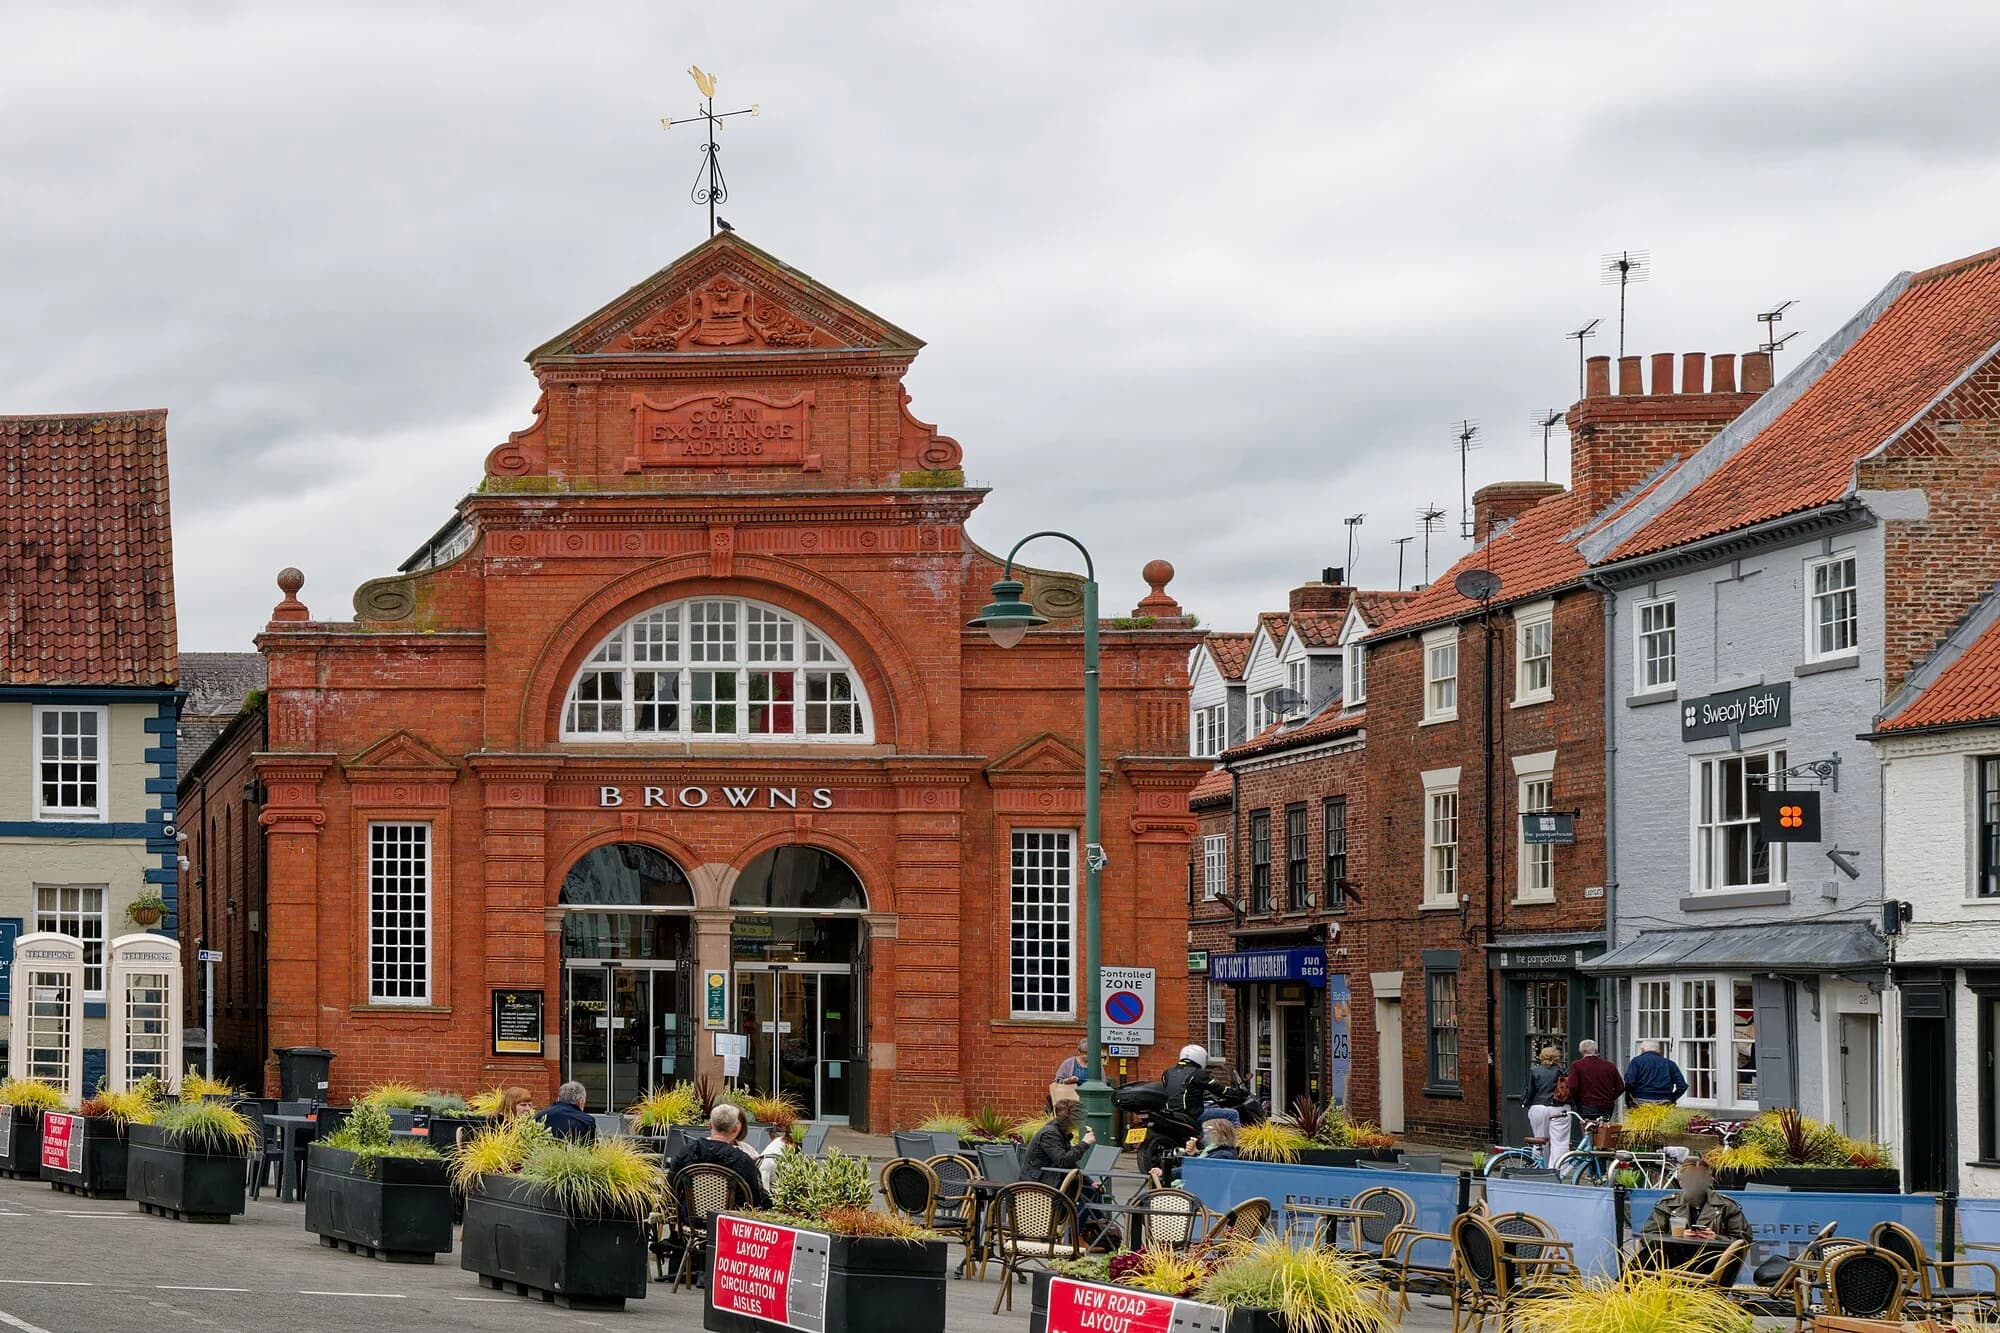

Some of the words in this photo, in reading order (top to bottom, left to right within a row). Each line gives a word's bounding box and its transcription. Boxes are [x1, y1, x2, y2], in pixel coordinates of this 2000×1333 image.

[690, 409, 756, 423] CORN
[652, 423, 795, 441] EXCHANGE
[1703, 699, 1747, 724] Sweaty
[1749, 693, 1780, 718] Betty
[599, 786, 834, 809] BROWNS
[28, 950, 75, 960] TELEPHONE
[124, 952, 170, 960] TELEPHONE
[1516, 953, 1526, 964] the
[1527, 950, 1568, 967] pamperhouse
[1100, 969, 1152, 979] Controlled
[1248, 954, 1287, 978] AMUSEMENTS
[1301, 966, 1324, 976] BEDS
[1105, 979, 1143, 989] ZONE
[1858, 994, 1869, 1005] 28
[732, 1223, 752, 1240] NEW
[753, 1227, 779, 1244] ROAD
[736, 1240, 769, 1260] LAYOUT
[718, 1257, 729, 1271] DO
[730, 1260, 747, 1276] NOT
[748, 1264, 770, 1282] PARK
[773, 1270, 785, 1285] IN
[721, 1275, 776, 1301] CIRCULATION
[733, 1295, 762, 1314] AISLES
[1074, 1287, 1106, 1308] NEW
[1107, 1294, 1147, 1316] ROAD
[1080, 1310, 1132, 1333] LAYOUT
